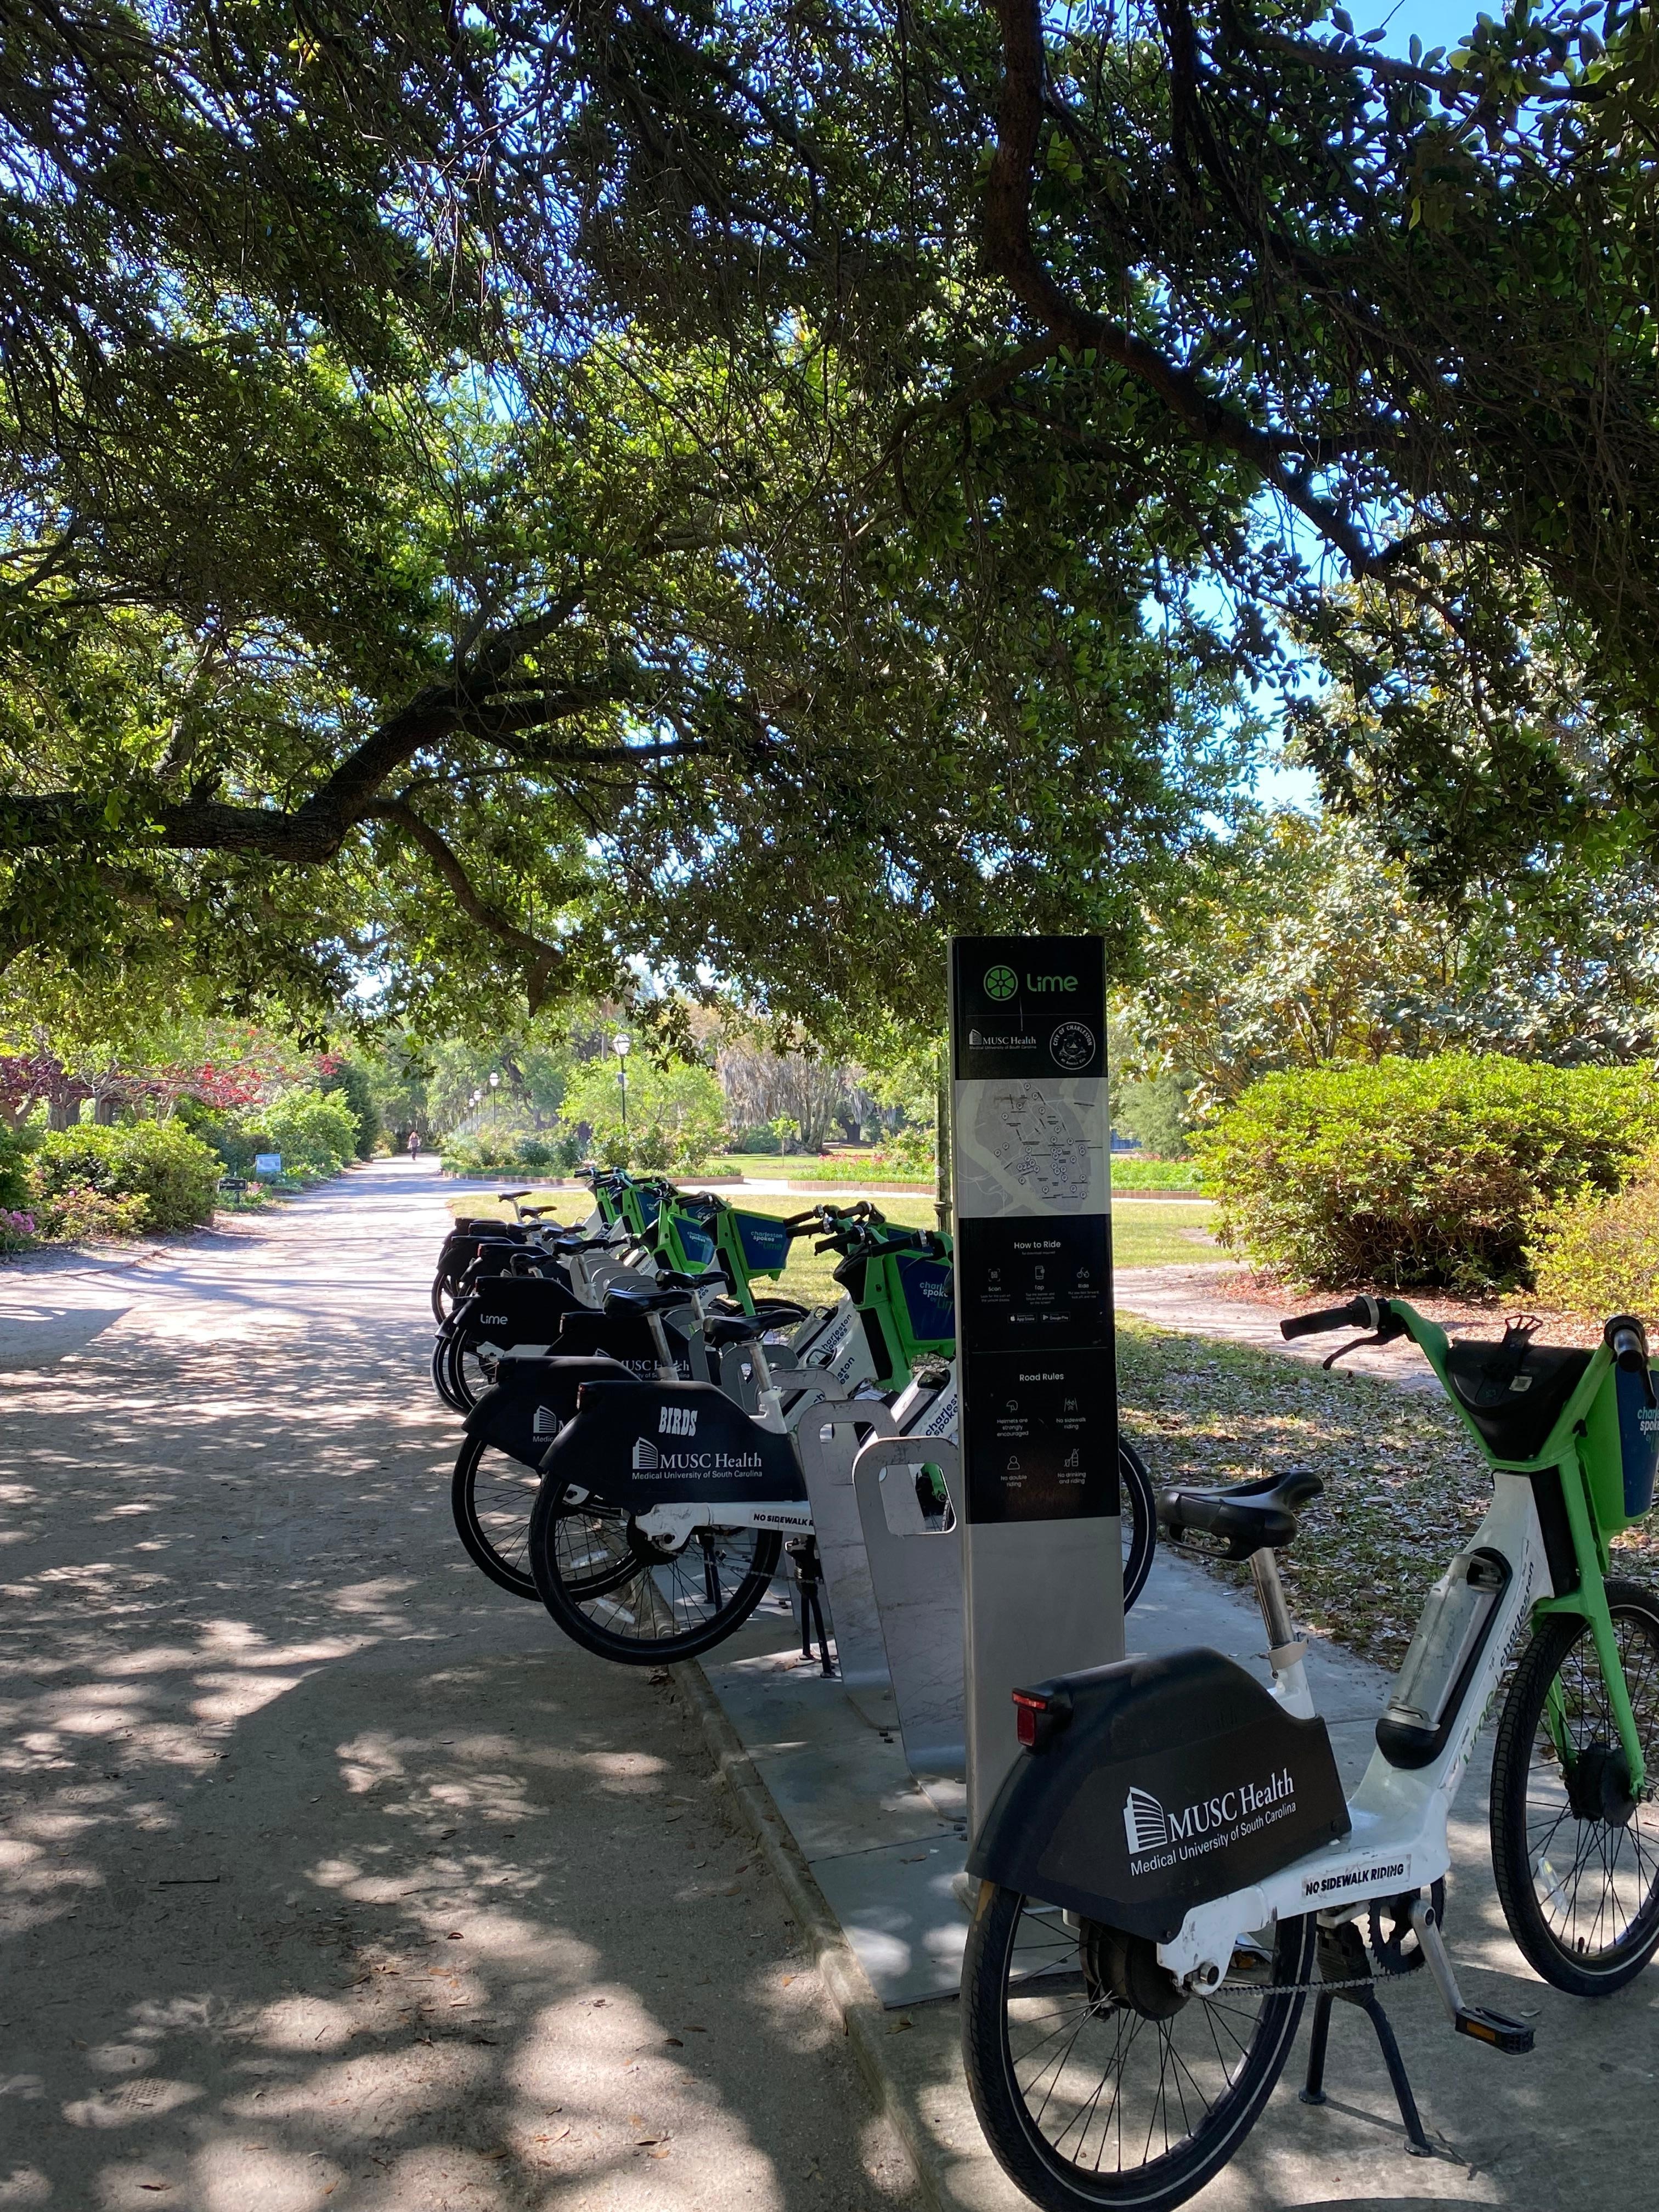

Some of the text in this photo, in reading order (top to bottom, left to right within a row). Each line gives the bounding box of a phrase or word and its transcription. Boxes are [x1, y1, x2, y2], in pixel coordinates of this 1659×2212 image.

[1026, 973, 1079, 992] Lime
[983, 1036, 1036, 1045] MUSC Health
[1066, 1025, 1093, 1046] CHARLESTON
[1033, 1240, 1042, 1249] to
[1043, 1240, 1061, 1248] Ride
[480, 1313, 508, 1325] Lime
[821, 1314, 851, 1350] harleston
[1019, 1372, 1064, 1381] Road Rules
[1637, 1406, 1659, 1420] charl
[658, 1406, 698, 1437] BIRDS
[1639, 1420, 1659, 1436] spok
[660, 1452, 763, 1469] MUSC Health
[632, 1471, 662, 1480] Medical
[664, 1471, 702, 1480] University
[703, 1470, 711, 1479] of
[712, 1470, 732, 1478] South
[753, 1513, 766, 1521] NO
[767, 1515, 808, 1526] SIDEWALK
[1167, 1768, 1294, 1842] MUSC Health
[1131, 1802, 1296, 1876] Medical University of South Carolina
[1306, 1864, 1404, 1896] NO SIDEWALK RIDING
